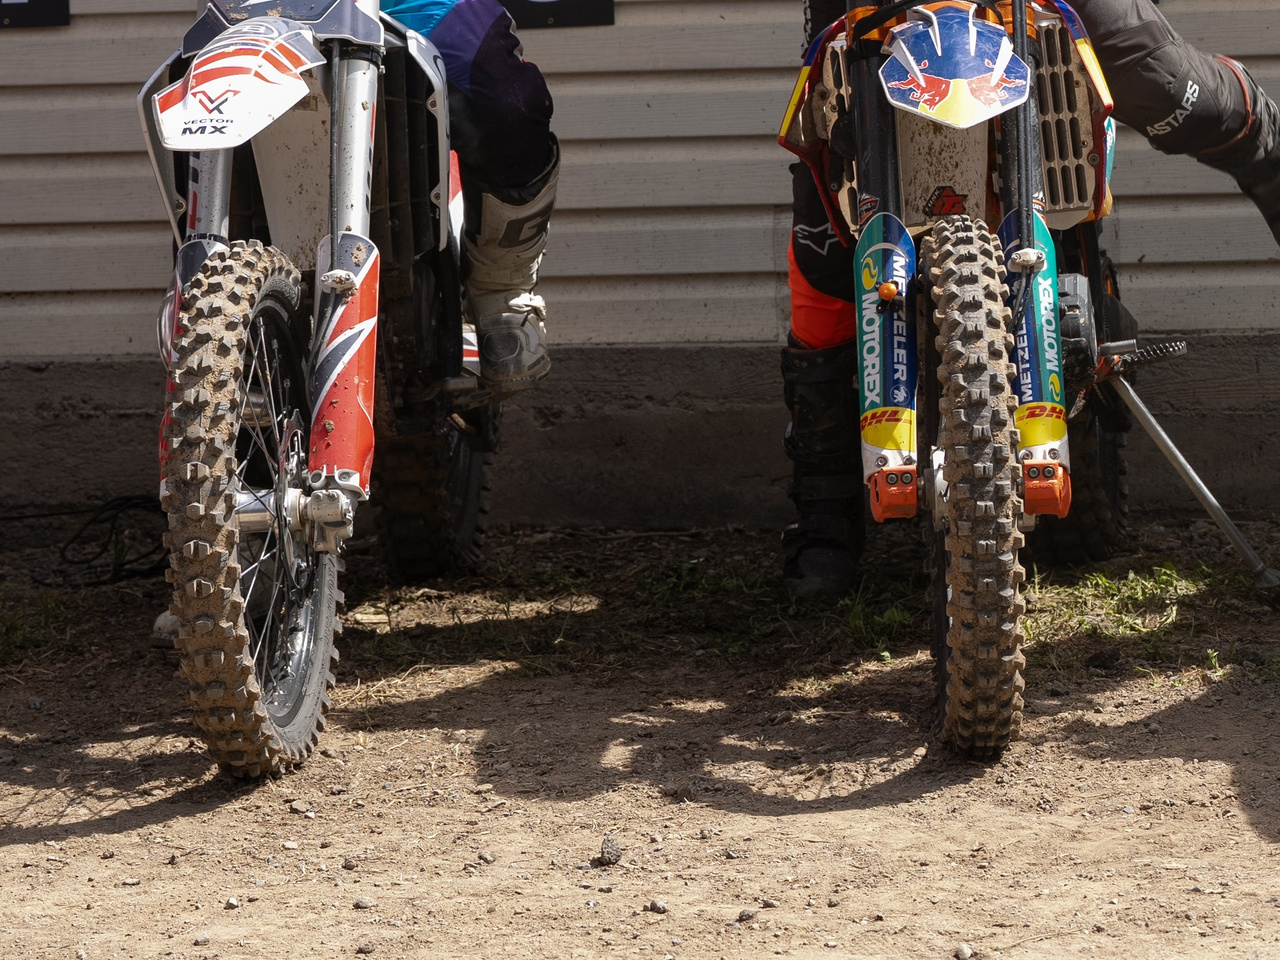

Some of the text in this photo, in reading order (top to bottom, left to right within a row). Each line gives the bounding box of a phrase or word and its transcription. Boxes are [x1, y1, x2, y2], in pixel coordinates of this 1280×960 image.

[181, 125, 228, 135] MX
[1146, 80, 1200, 137] ASTARS
[861, 292, 881, 409] MOTOREX
[892, 255, 907, 380] METZELER
[1038, 276, 1060, 372] MOTOREX
[860, 409, 908, 432] DHL
